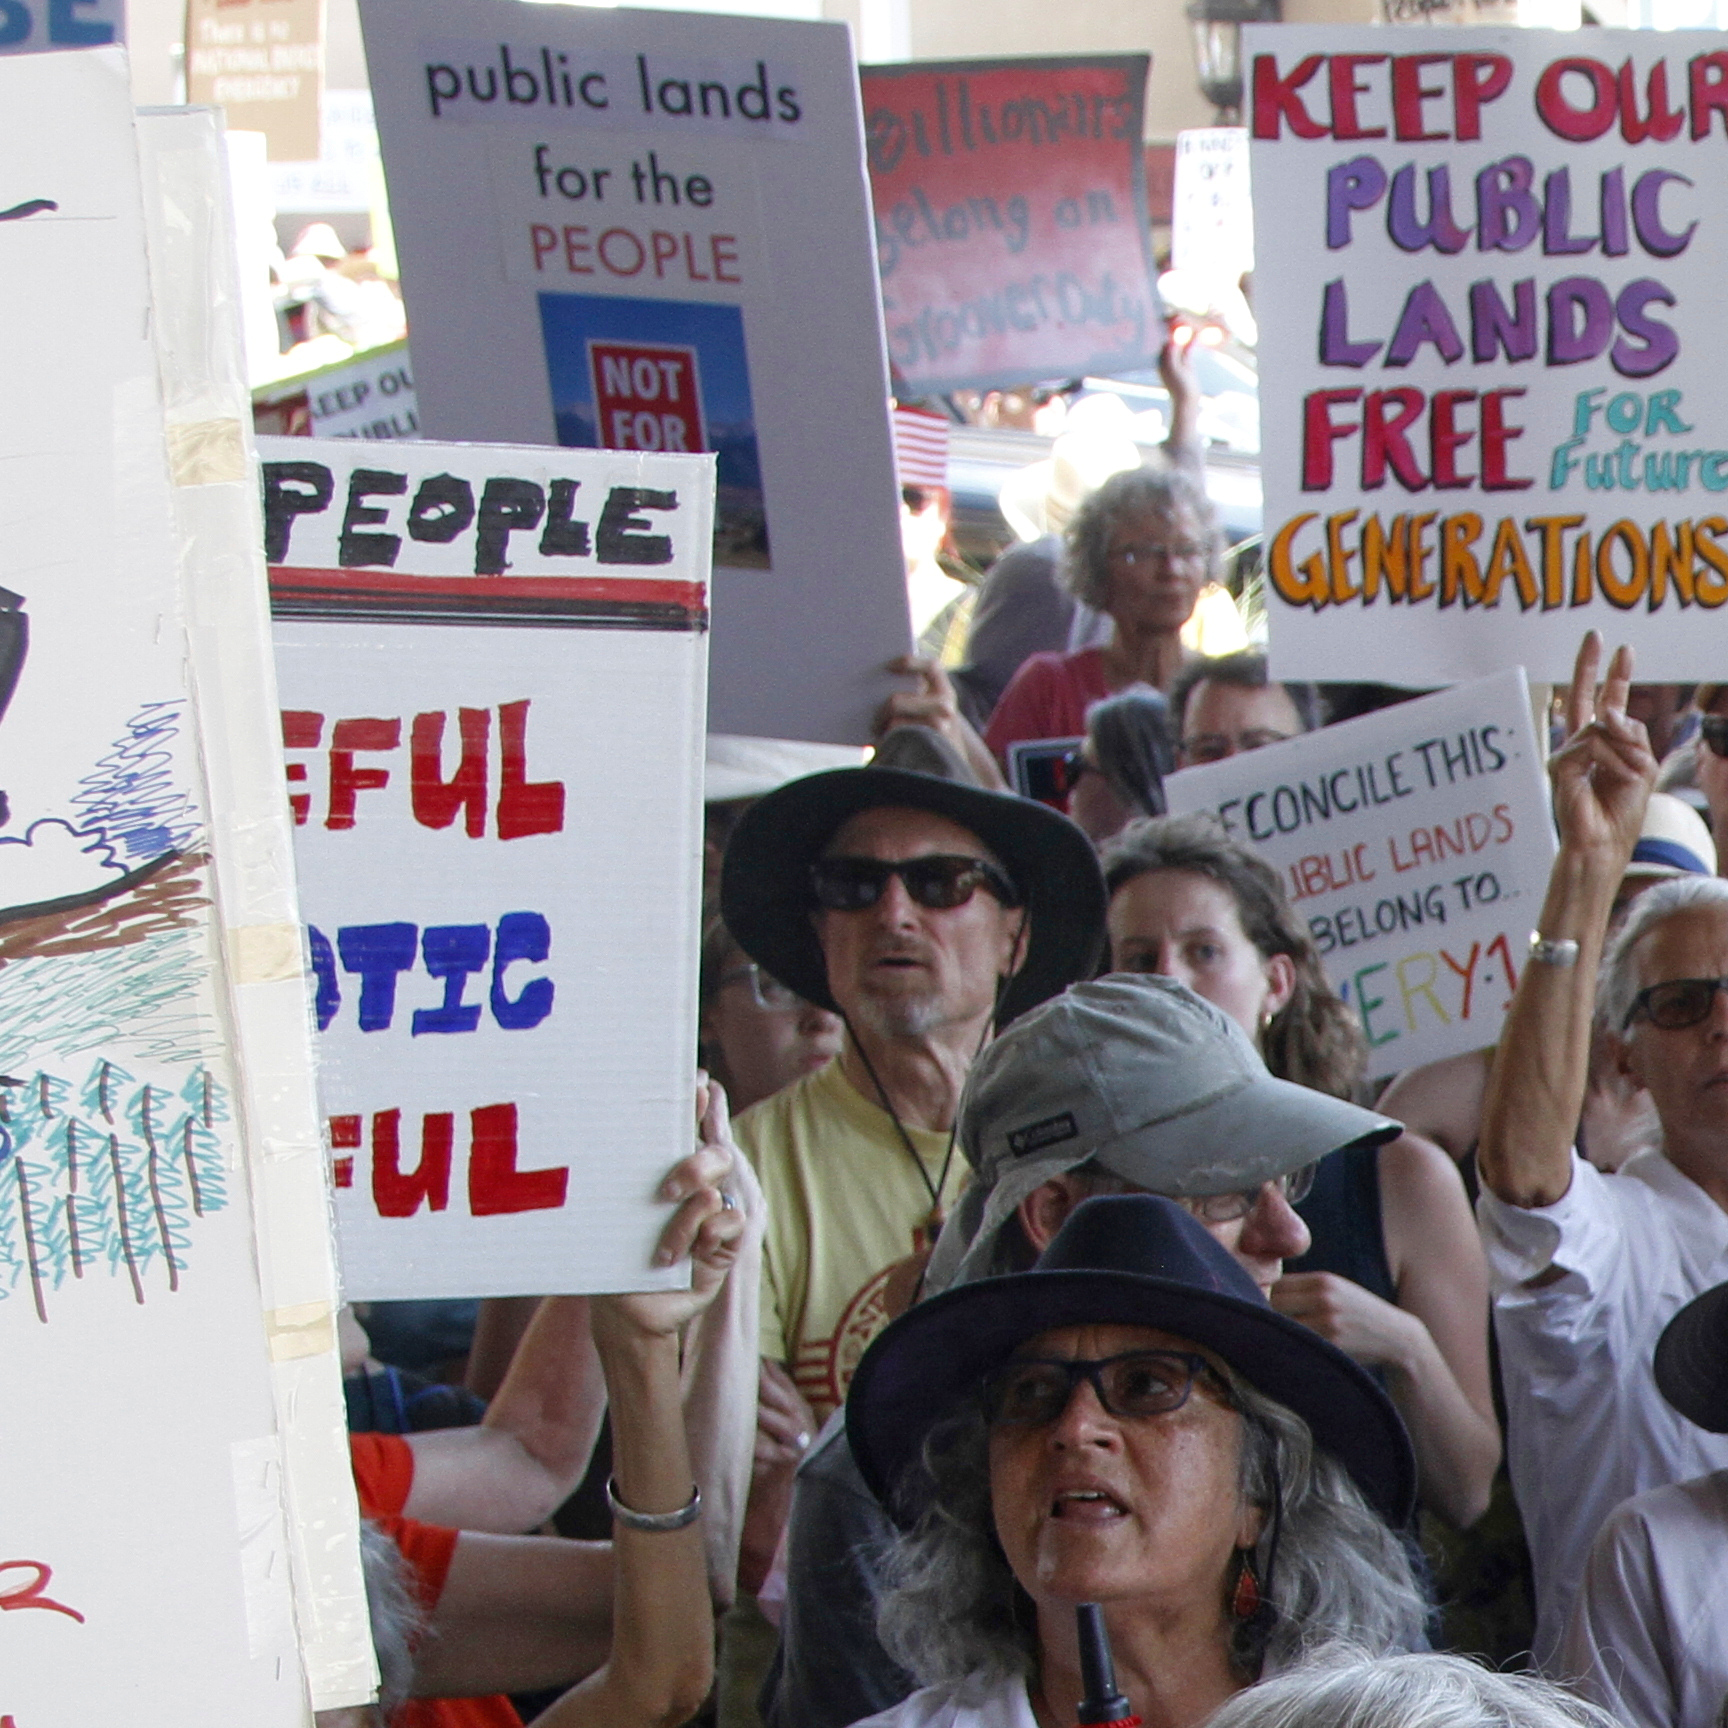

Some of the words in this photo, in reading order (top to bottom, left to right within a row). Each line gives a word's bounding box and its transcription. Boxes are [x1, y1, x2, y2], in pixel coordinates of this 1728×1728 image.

[427, 45, 610, 118] public
[638, 55, 803, 124] lands
[1251, 52, 1514, 144] KEEP
[534, 144, 611, 200] for
[630, 152, 714, 207] the
[1052, 188, 1118, 230] on
[1324, 155, 1699, 257] PUBLIC
[528, 223, 744, 285] PEOPLE
[1319, 277, 1681, 378] LANDS
[602, 352, 683, 401] NOT
[611, 410, 689, 451] FOR
[1299, 387, 1535, 493] FREE
[1573, 387, 1694, 437] FOR
[264, 460, 679, 576] PEOPLE
[1387, 803, 1517, 874] LANDS
[1308, 885, 1448, 953] BELONG
